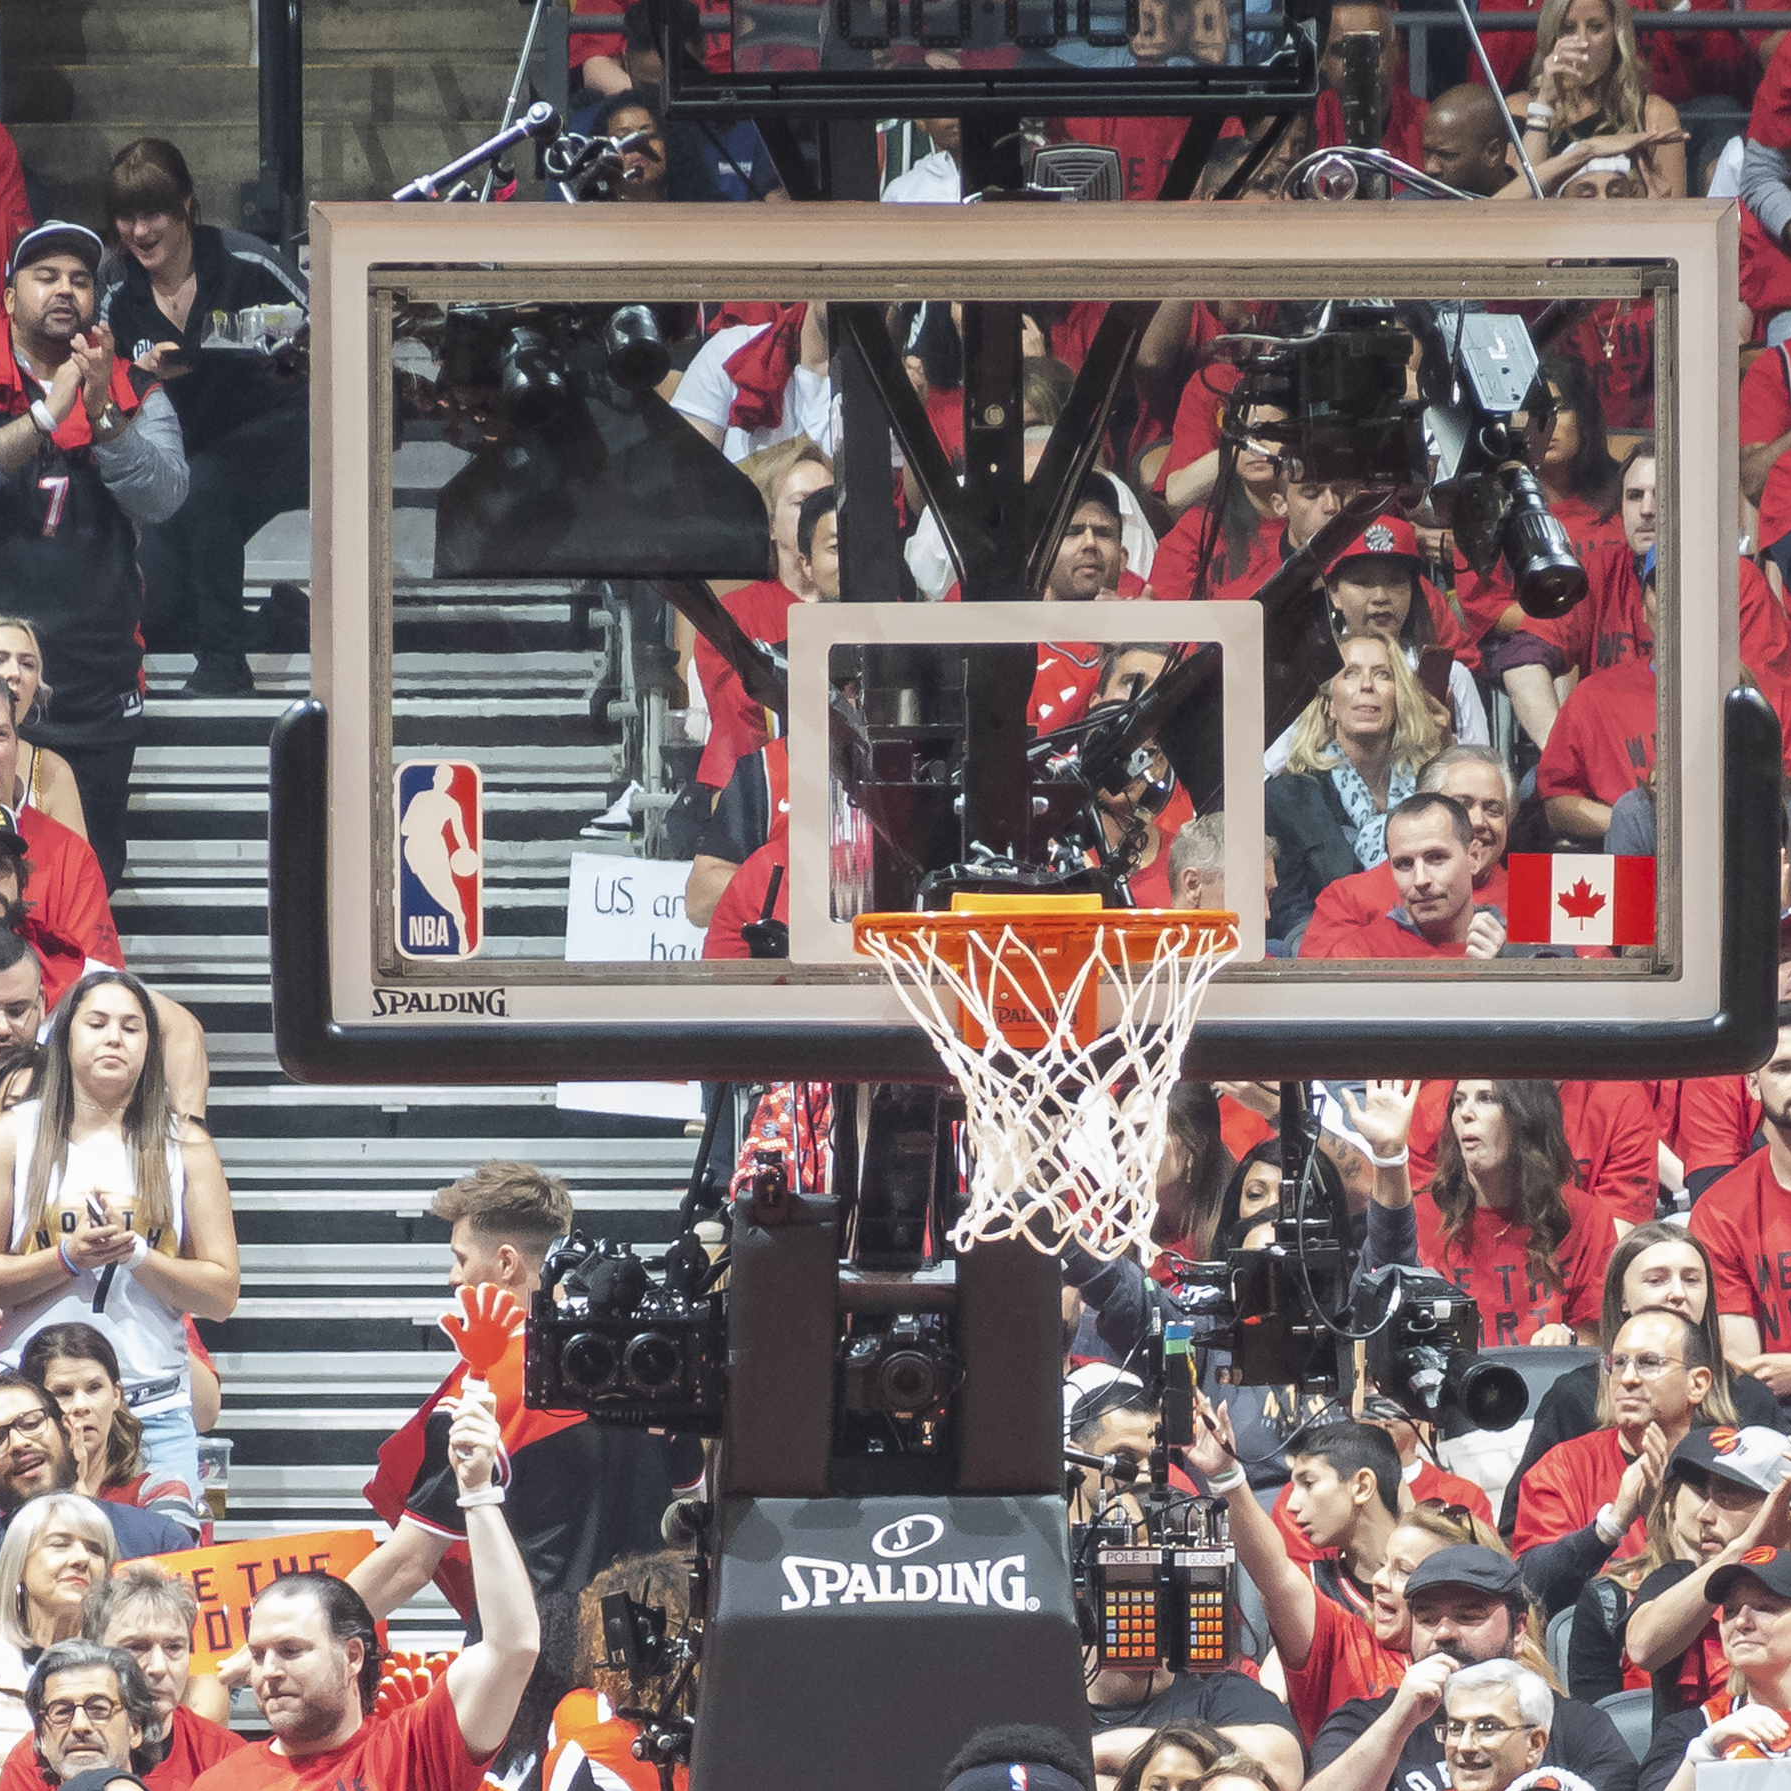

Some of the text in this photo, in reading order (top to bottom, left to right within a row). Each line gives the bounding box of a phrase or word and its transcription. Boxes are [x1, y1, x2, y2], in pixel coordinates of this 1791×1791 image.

[39, 476, 69, 537] 7
[408, 915, 449, 946] NBA
[372, 987, 507, 1018] SPALDING
[36, 1210, 163, 1248] NOTH
[1106, 1552, 1139, 1562] POLE
[780, 1554, 1027, 1613] SPALDING
